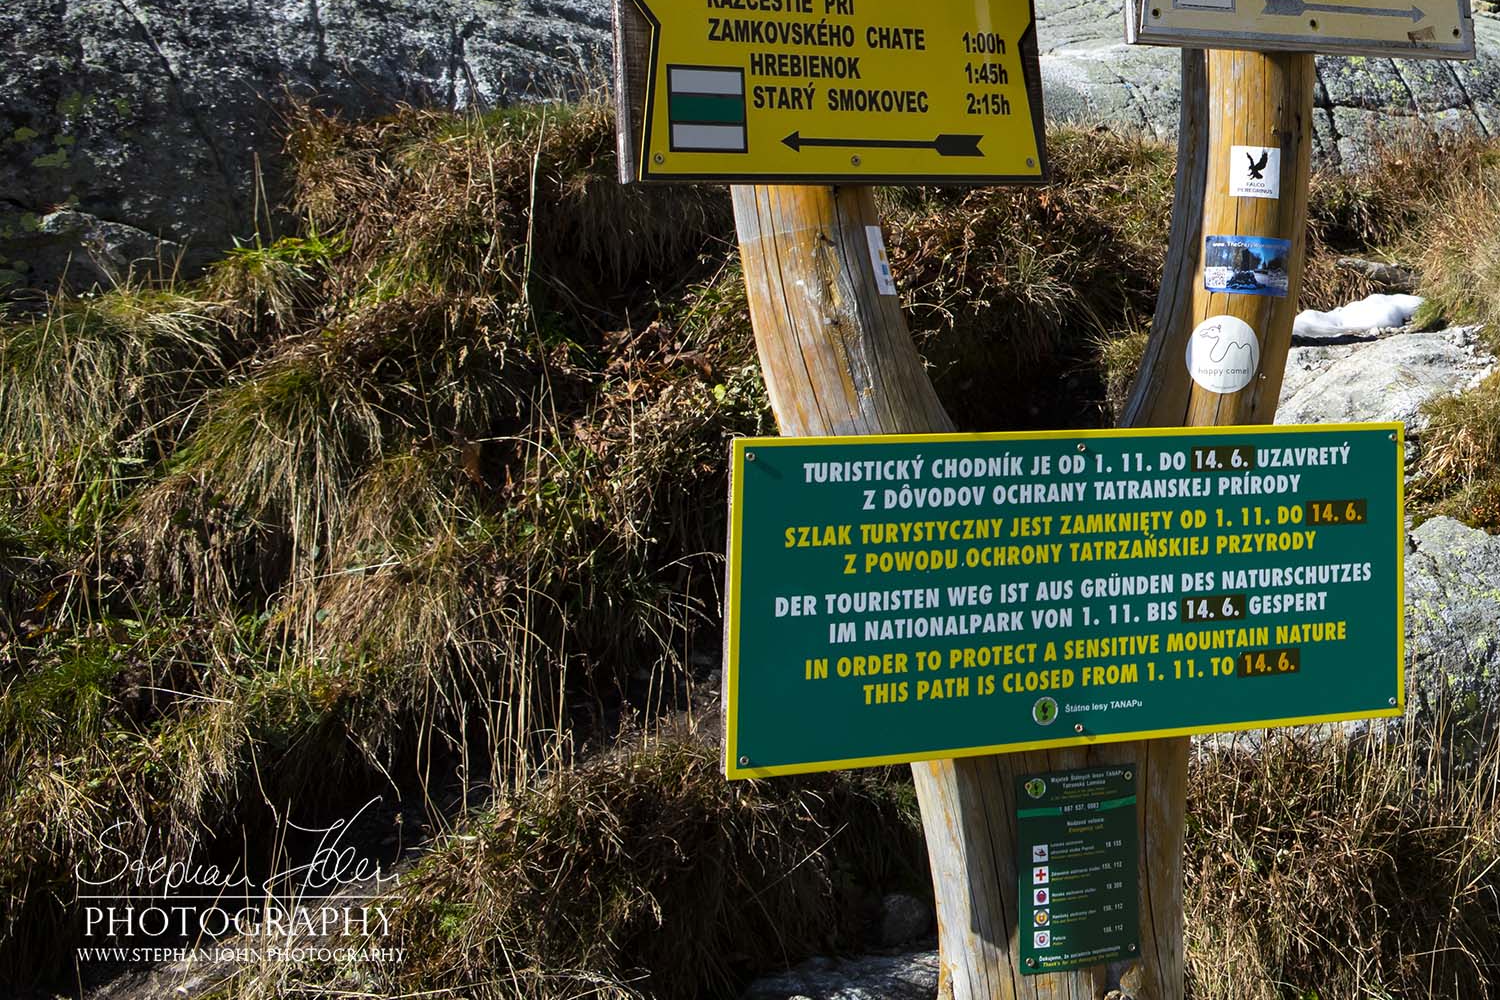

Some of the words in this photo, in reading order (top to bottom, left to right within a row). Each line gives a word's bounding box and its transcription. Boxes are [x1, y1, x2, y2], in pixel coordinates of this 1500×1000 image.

[709, 18, 854, 47] ZAMKOVSKÉHO
[867, 27, 925, 50] CHATE
[963, 32, 1006, 54] 1:00h
[751, 53, 861, 79] HREBIENOK
[965, 63, 1008, 84] 1:45h
[753, 82, 815, 110] STARÝ
[828, 89, 928, 113] SMOKOVEC
[967, 93, 1010, 115] 2:15h
[804, 454, 924, 482] TURISTICKÝ
[932, 452, 1023, 478] CHODNÍK
[1031, 456, 1050, 475] JE
[1059, 455, 1085, 474] OD
[1096, 454, 1112, 473] 1.
[1122, 453, 1152, 472] 11.
[1160, 452, 1185, 470] DO
[1195, 450, 1222, 469] 14.
[1231, 449, 1248, 467] 6.
[1258, 442, 1350, 467] UZAVRETÝ
[863, 490, 876, 510] Z
[884, 484, 985, 509] DÔVODOV
[993, 482, 1087, 504] OCHRANY
[1094, 478, 1210, 500] TATRANSKEJ
[1219, 471, 1300, 495] PRÍRODY
[785, 525, 851, 547] SZLAK
[860, 519, 1003, 544] TURYSTYCZNY
[1010, 516, 1052, 537] JEST
[1060, 511, 1173, 536] ZAMKNIĘTY
[1180, 510, 1206, 528] OD
[1216, 509, 1232, 527] 1.
[1242, 507, 1270, 526] 11.
[1278, 505, 1302, 524] DO
[1313, 504, 1338, 521] 14.
[1346, 503, 1361, 520] 6.
[844, 554, 856, 574] Z
[866, 549, 957, 573] POWODU
[966, 544, 1062, 567] OCHRONY
[1070, 534, 1208, 561] TATRZAŃSKIEJ
[1217, 531, 1316, 554] PRZYRODY
[776, 596, 816, 617] DER
[825, 588, 939, 614] TOURISTEN
[948, 585, 992, 606] WEG
[1001, 583, 1029, 603] IST
[1036, 580, 1073, 601] AUS
[1081, 573, 1173, 598] GRÜNDEN
[1182, 572, 1214, 592] DES
[1222, 563, 1371, 589] NATURSCHUTZES
[830, 622, 856, 643] IM
[865, 611, 1023, 641] NATIONALPARK
[1032, 608, 1072, 629] VON
[1083, 607, 1099, 625] 1.
[1110, 604, 1139, 624] 11.
[1148, 601, 1177, 621] BIS
[1187, 600, 1214, 618] 14.
[1222, 598, 1239, 616] 6.
[1249, 592, 1327, 614] GESPERT
[806, 659, 828, 680] IN
[837, 654, 908, 677] ORDER
[916, 651, 941, 671] TO
[950, 644, 1037, 669] PROTECT
[1044, 642, 1056, 661] A
[1065, 634, 1159, 660] SENSITIVE
[1167, 627, 1268, 652] MOUNTAIN
[1277, 621, 1346, 644] NATURE
[863, 682, 908, 704] THIS
[917, 677, 969, 700] PATH
[978, 675, 995, 695] IS
[1003, 669, 1074, 693] CLOSED
[1083, 664, 1138, 686] FROM
[1147, 662, 1164, 681] 1.
[1174, 659, 1203, 679] 11.
[1211, 657, 1234, 676] TO
[1245, 654, 1271, 673] 14.
[1278, 652, 1294, 671] 6.
